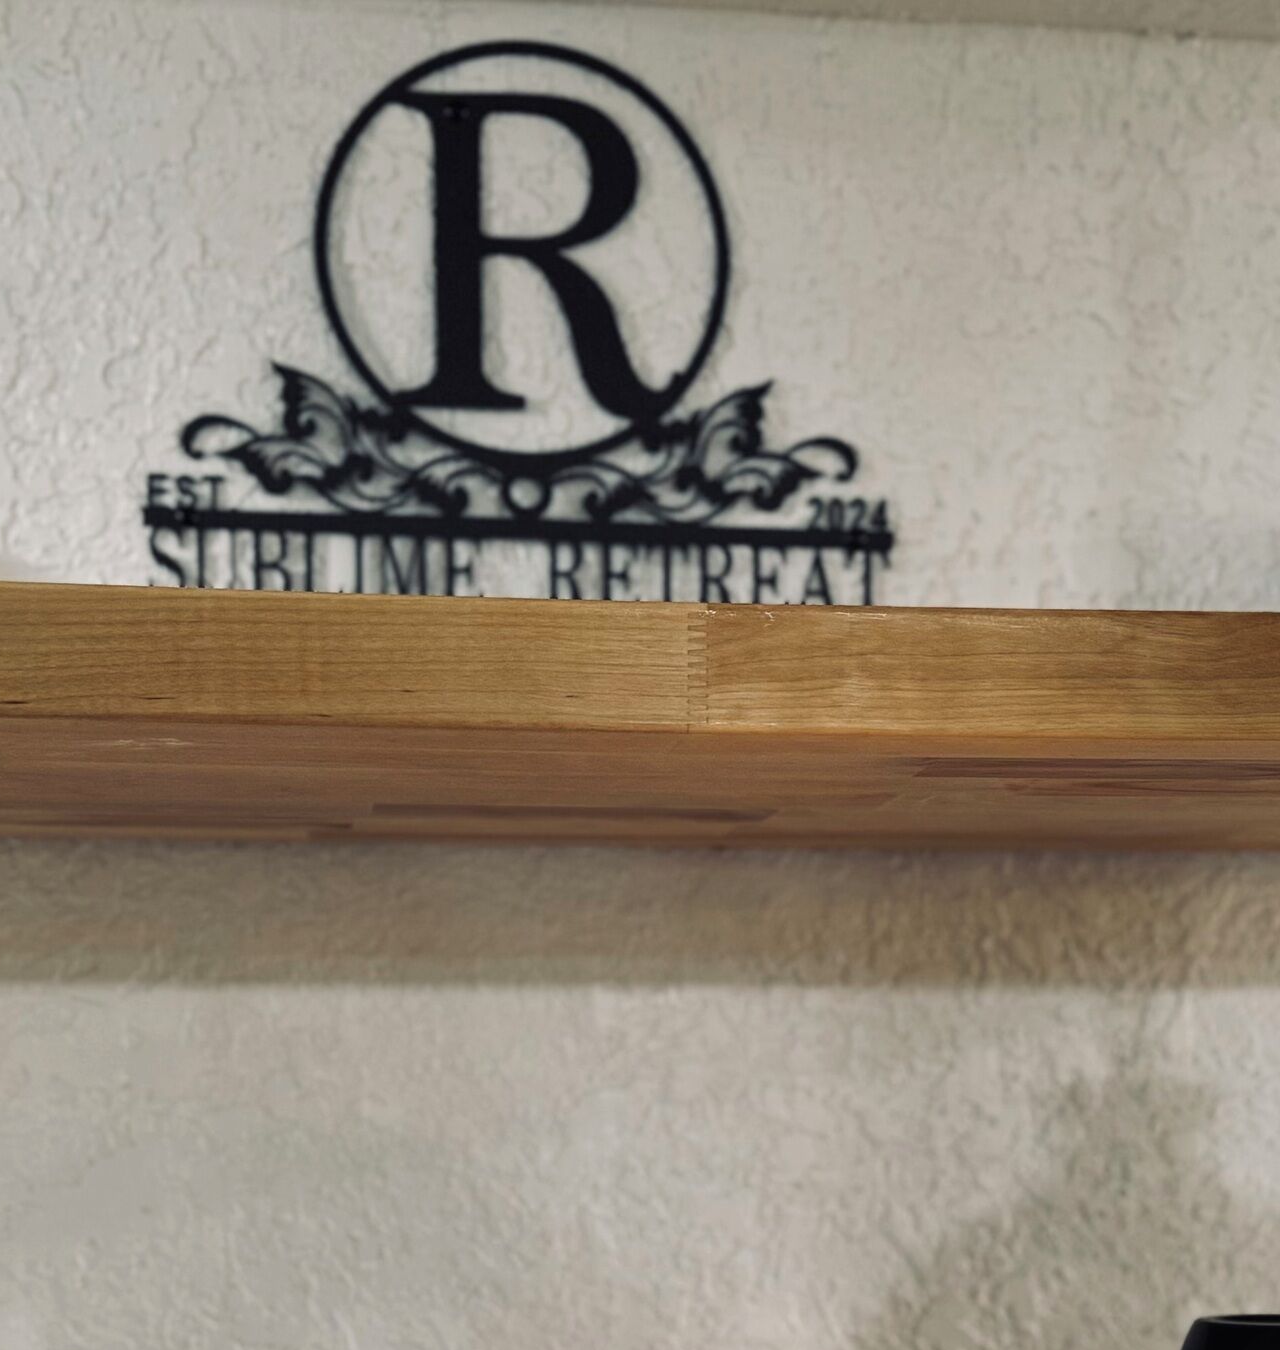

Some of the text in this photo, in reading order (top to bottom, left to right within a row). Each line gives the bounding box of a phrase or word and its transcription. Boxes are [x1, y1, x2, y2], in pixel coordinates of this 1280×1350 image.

[384, 92, 680, 420] R
[148, 474, 224, 510] EST
[810, 498, 888, 532] 2024
[149, 524, 892, 606] SUBLIME RETREAT
